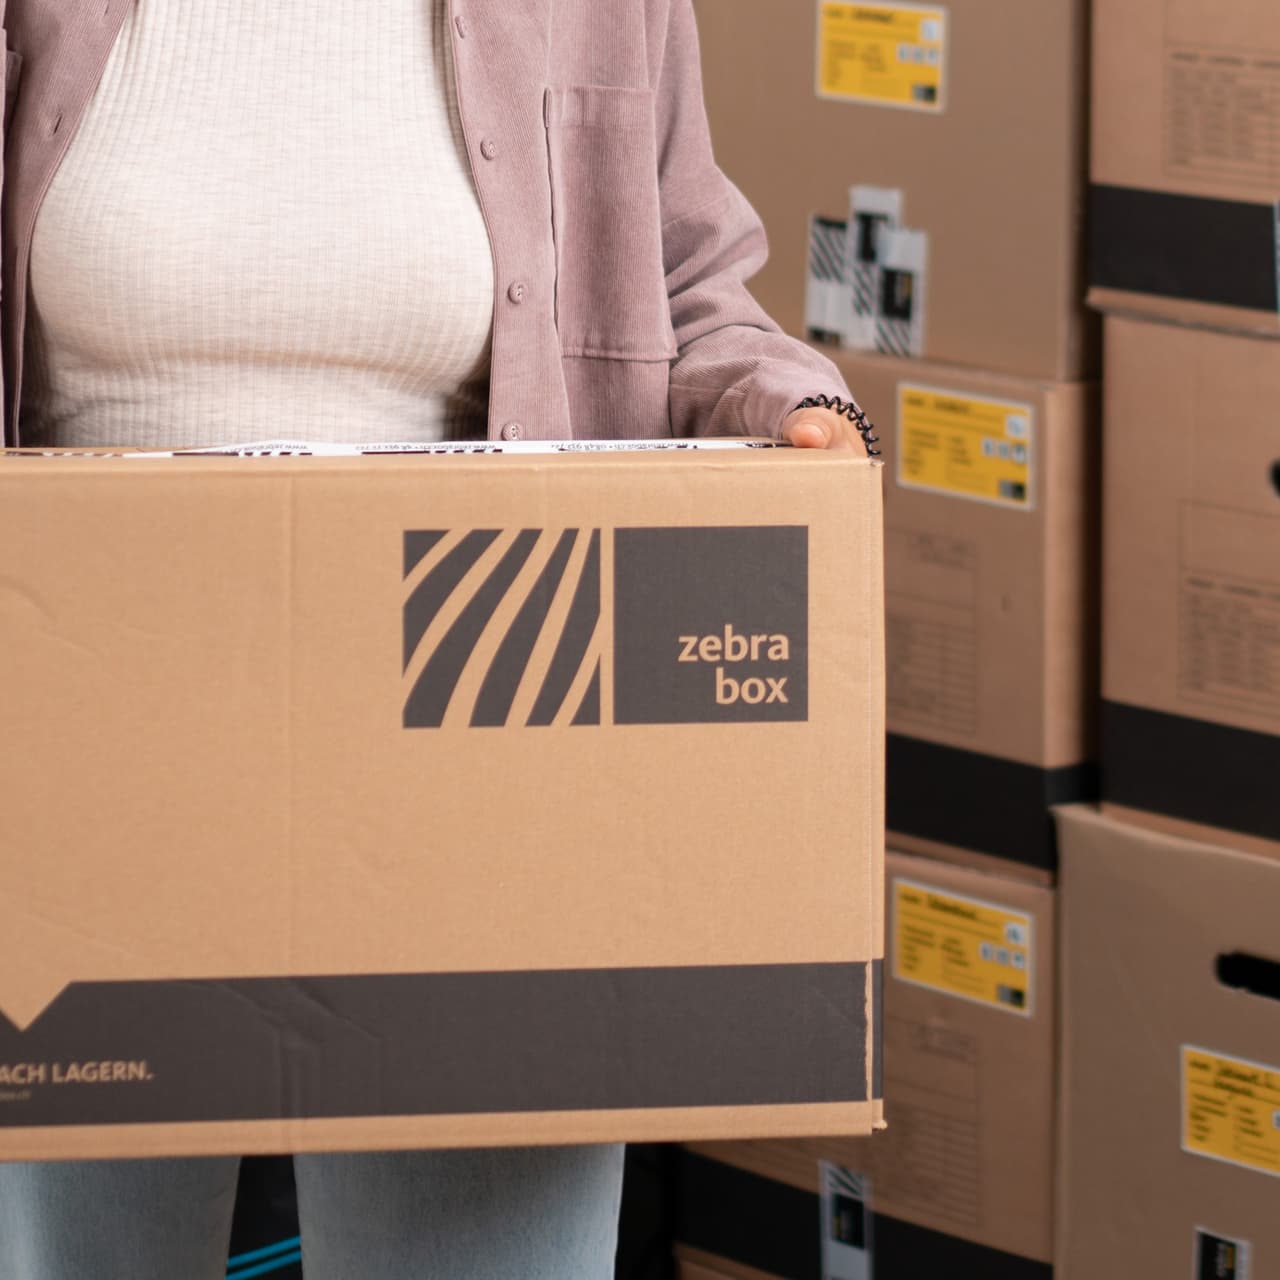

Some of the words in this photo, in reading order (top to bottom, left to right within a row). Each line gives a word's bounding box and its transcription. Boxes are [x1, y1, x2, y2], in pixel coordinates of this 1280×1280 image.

[677, 624, 790, 662] zebra
[715, 667, 789, 705] box
[51, 1059, 155, 1084] LAGERN.
